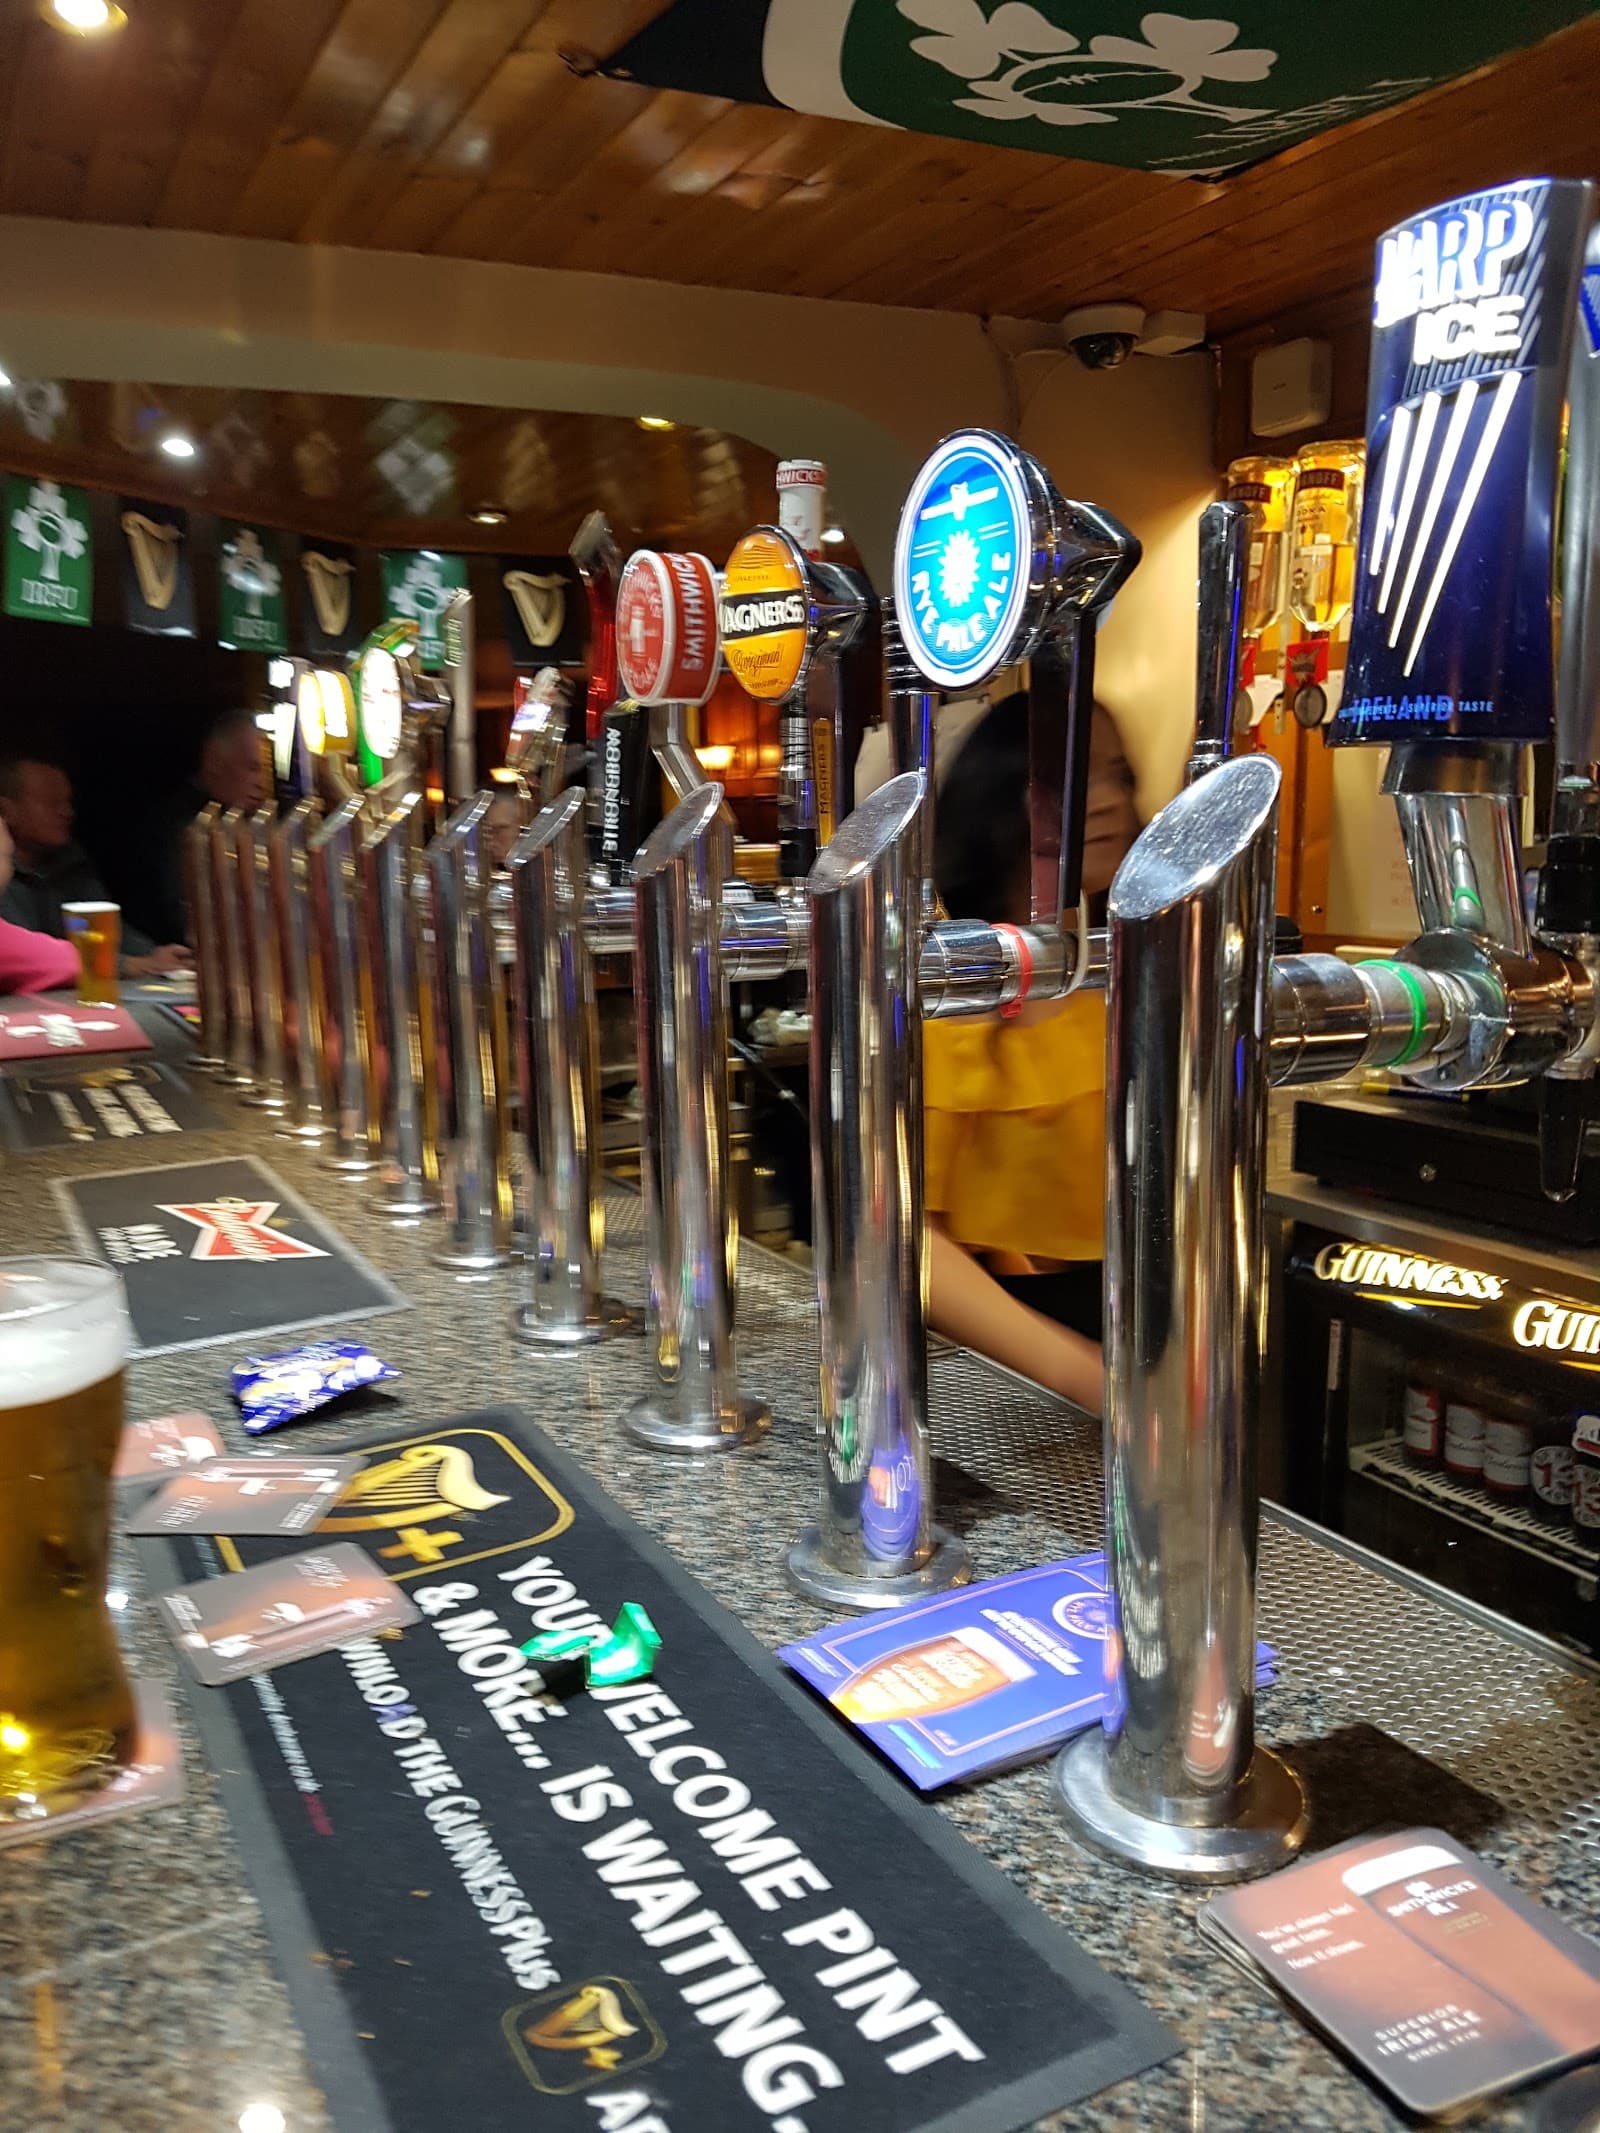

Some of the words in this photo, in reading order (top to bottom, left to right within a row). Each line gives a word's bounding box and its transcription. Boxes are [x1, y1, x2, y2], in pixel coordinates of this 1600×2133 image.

[1412, 294, 1525, 365] ICE
[1458, 701, 1495, 713] TASTE
[1313, 1242, 1510, 1301] GUINNESS
[412, 1582, 480, 1617] &
[539, 1765, 634, 1823] IS
[393, 1737, 464, 1798] THE
[588, 1683, 832, 1911] ELCOME
[782, 1907, 987, 2075] PINT
[1376, 2026, 1439, 2057] IRISH
[1440, 2008, 1484, 2033] ALE
